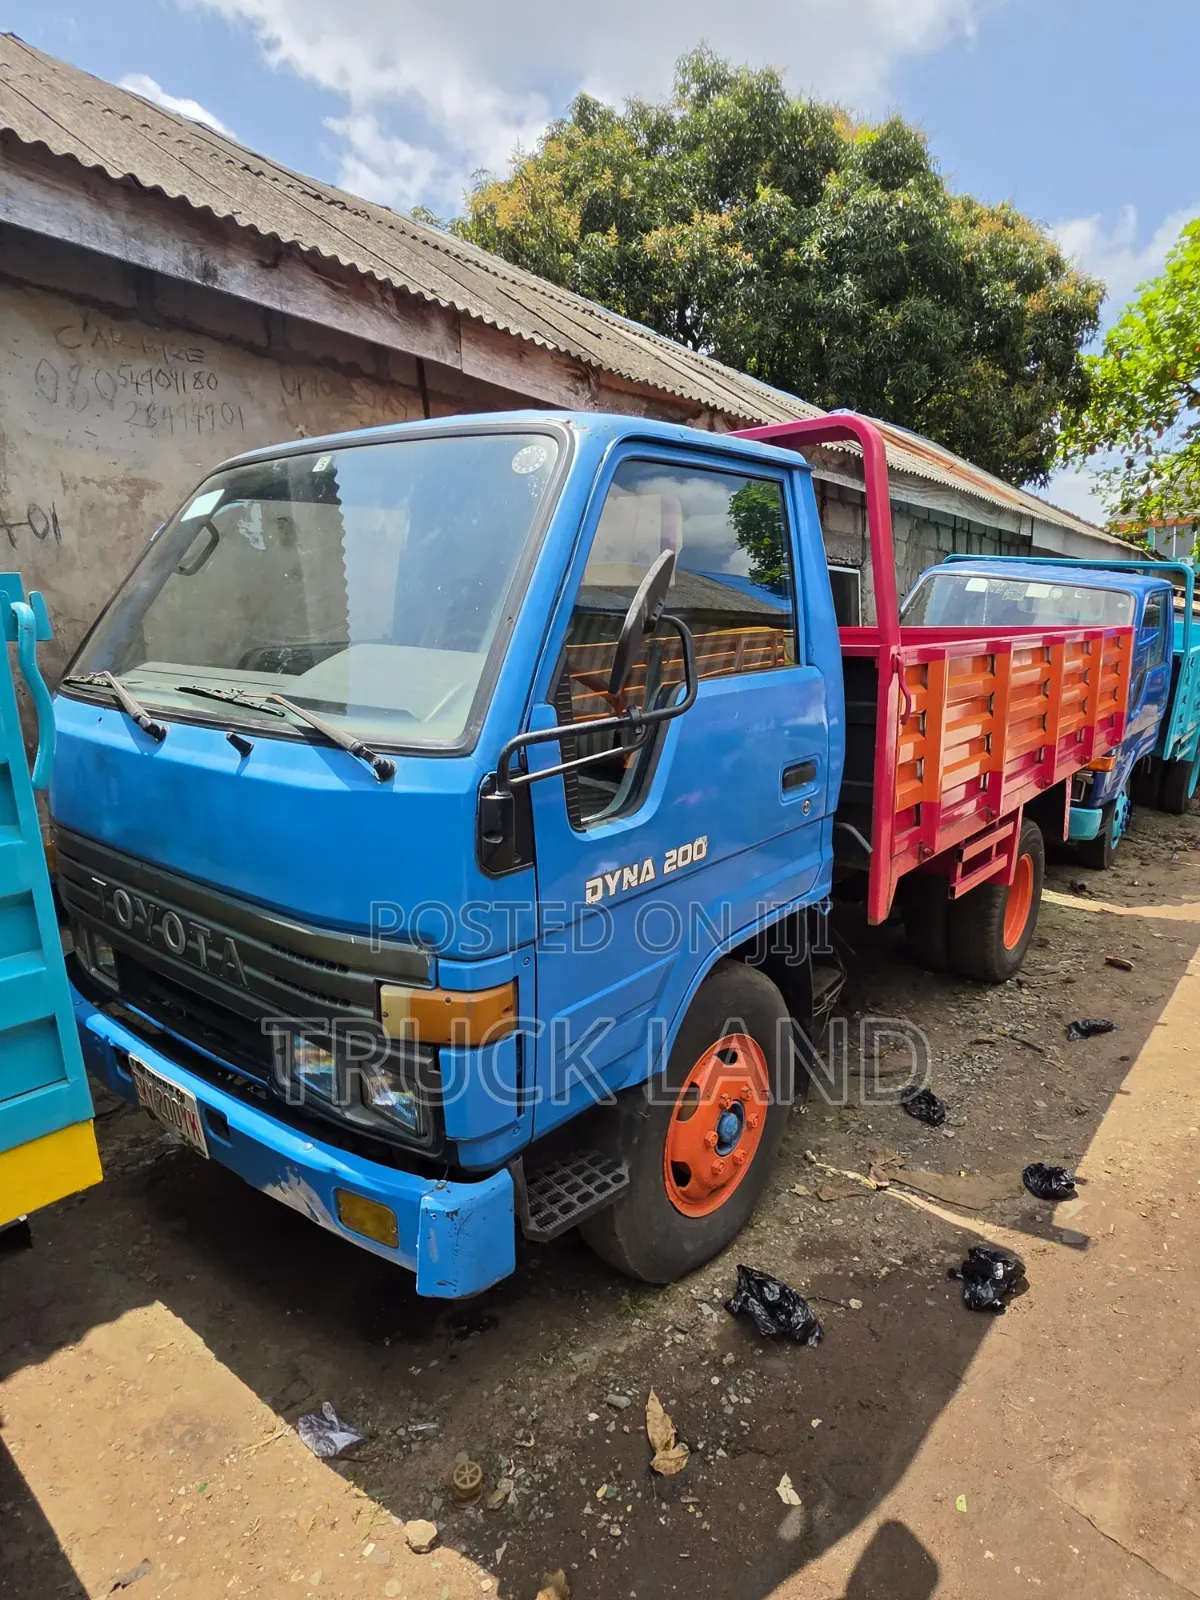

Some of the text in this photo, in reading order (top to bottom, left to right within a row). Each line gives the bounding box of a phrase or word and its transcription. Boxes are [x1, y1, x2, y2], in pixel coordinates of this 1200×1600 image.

[585, 835, 708, 905] DYNA 200
[91, 877, 250, 990] TOYOTA
